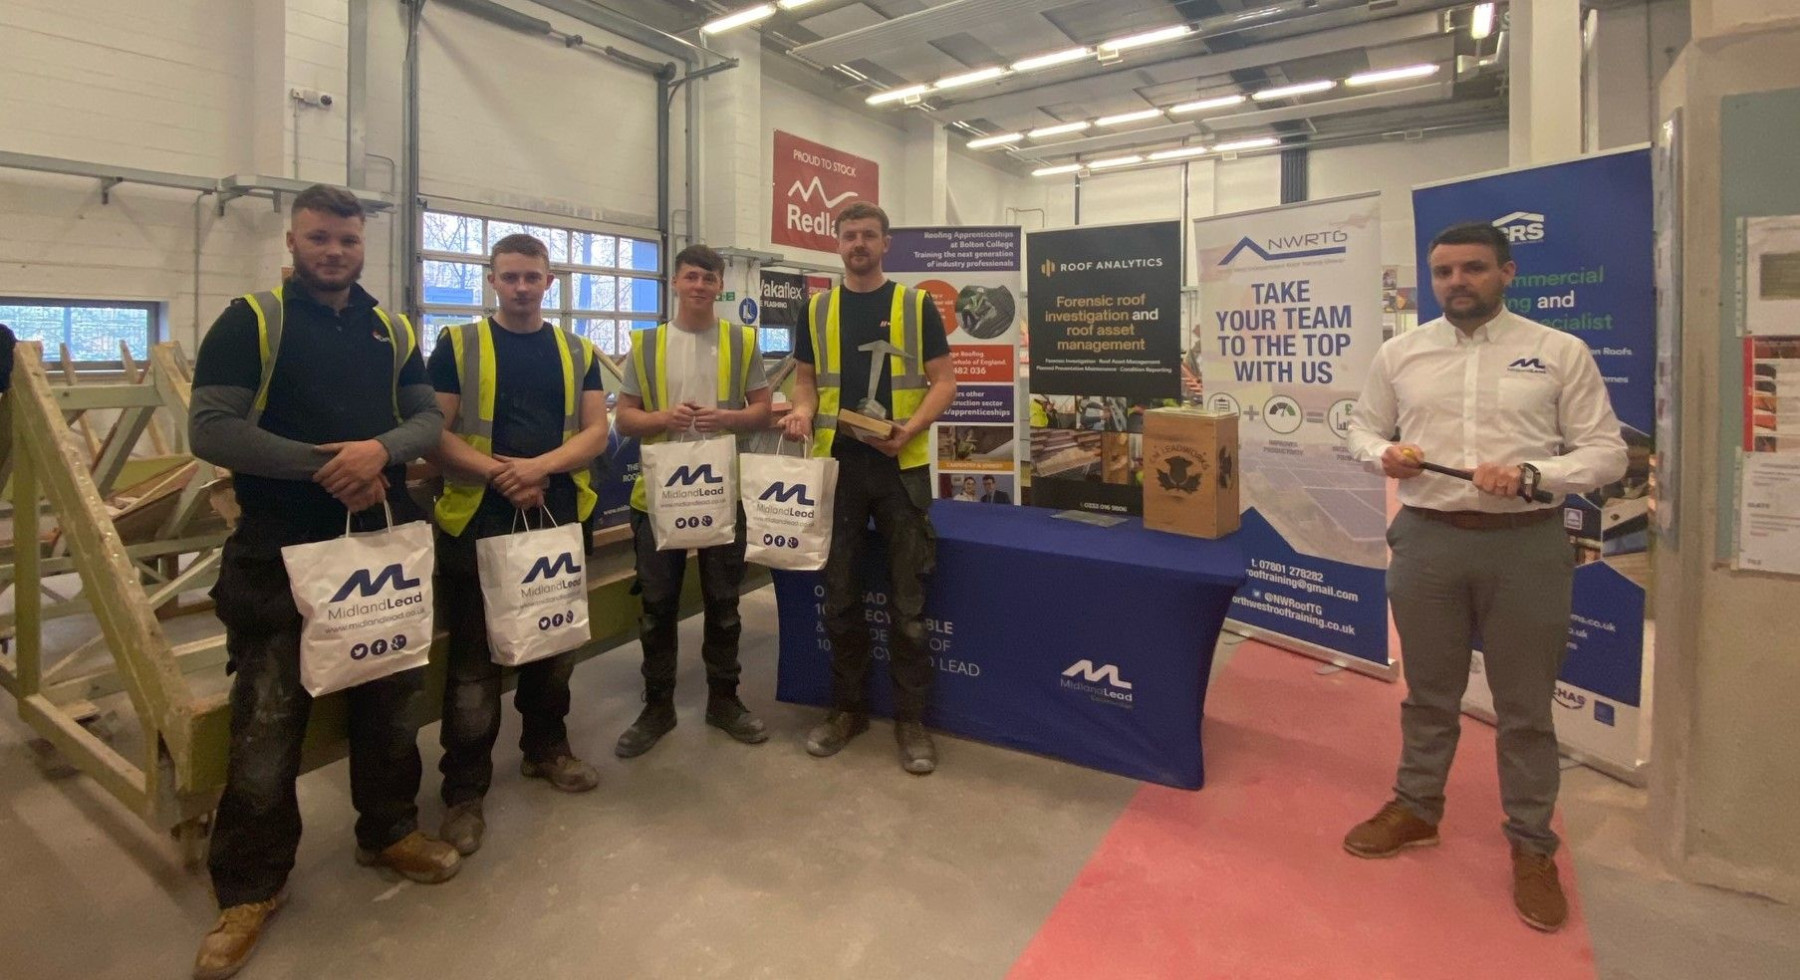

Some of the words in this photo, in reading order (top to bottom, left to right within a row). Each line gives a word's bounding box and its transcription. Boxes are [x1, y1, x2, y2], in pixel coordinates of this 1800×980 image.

[793, 149, 820, 167] PROUD
[821, 158, 832, 170] TO
[833, 162, 856, 177] STOCK
[954, 231, 1013, 239] Apprenticeships
[1268, 230, 1348, 250] NWRTG
[986, 240, 1013, 249] College
[913, 251, 942, 259] Training
[974, 251, 1013, 259] generation
[936, 260, 965, 268] industry
[966, 259, 1013, 268] professionals
[1060, 262, 1093, 272] ROOF
[1096, 258, 1163, 270] ANALYTICS
[1251, 280, 1310, 304] TAKE
[1537, 290, 1575, 309] and
[1056, 295, 1113, 308] Forensic
[1117, 293, 1146, 306] roof
[1045, 309, 1129, 324] investigation
[1132, 308, 1159, 321] and
[1216, 309, 1276, 331] YOUR
[1283, 305, 1352, 329] TEAM
[1066, 324, 1094, 336] roof
[1097, 323, 1135, 336] asset
[1057, 338, 1146, 353] management
[1218, 336, 1245, 356] TO
[1252, 335, 1296, 356] THE
[1303, 334, 1350, 356] TOP
[1603, 347, 1632, 355] Roofs
[1234, 361, 1293, 382] WITH
[1301, 361, 1333, 384] US
[662, 487, 724, 499] MidlandLead
[757, 504, 815, 518] MidlandLead
[1259, 560, 1286, 574] 07801
[1289, 566, 1324, 582] 278282
[328, 592, 422, 620] MidlandLead
[1264, 592, 1322, 615] @NWRoofTG
[929, 637, 951, 652] OF
[940, 658, 980, 677] LEAD
[1060, 679, 1133, 702] MidlandLead
